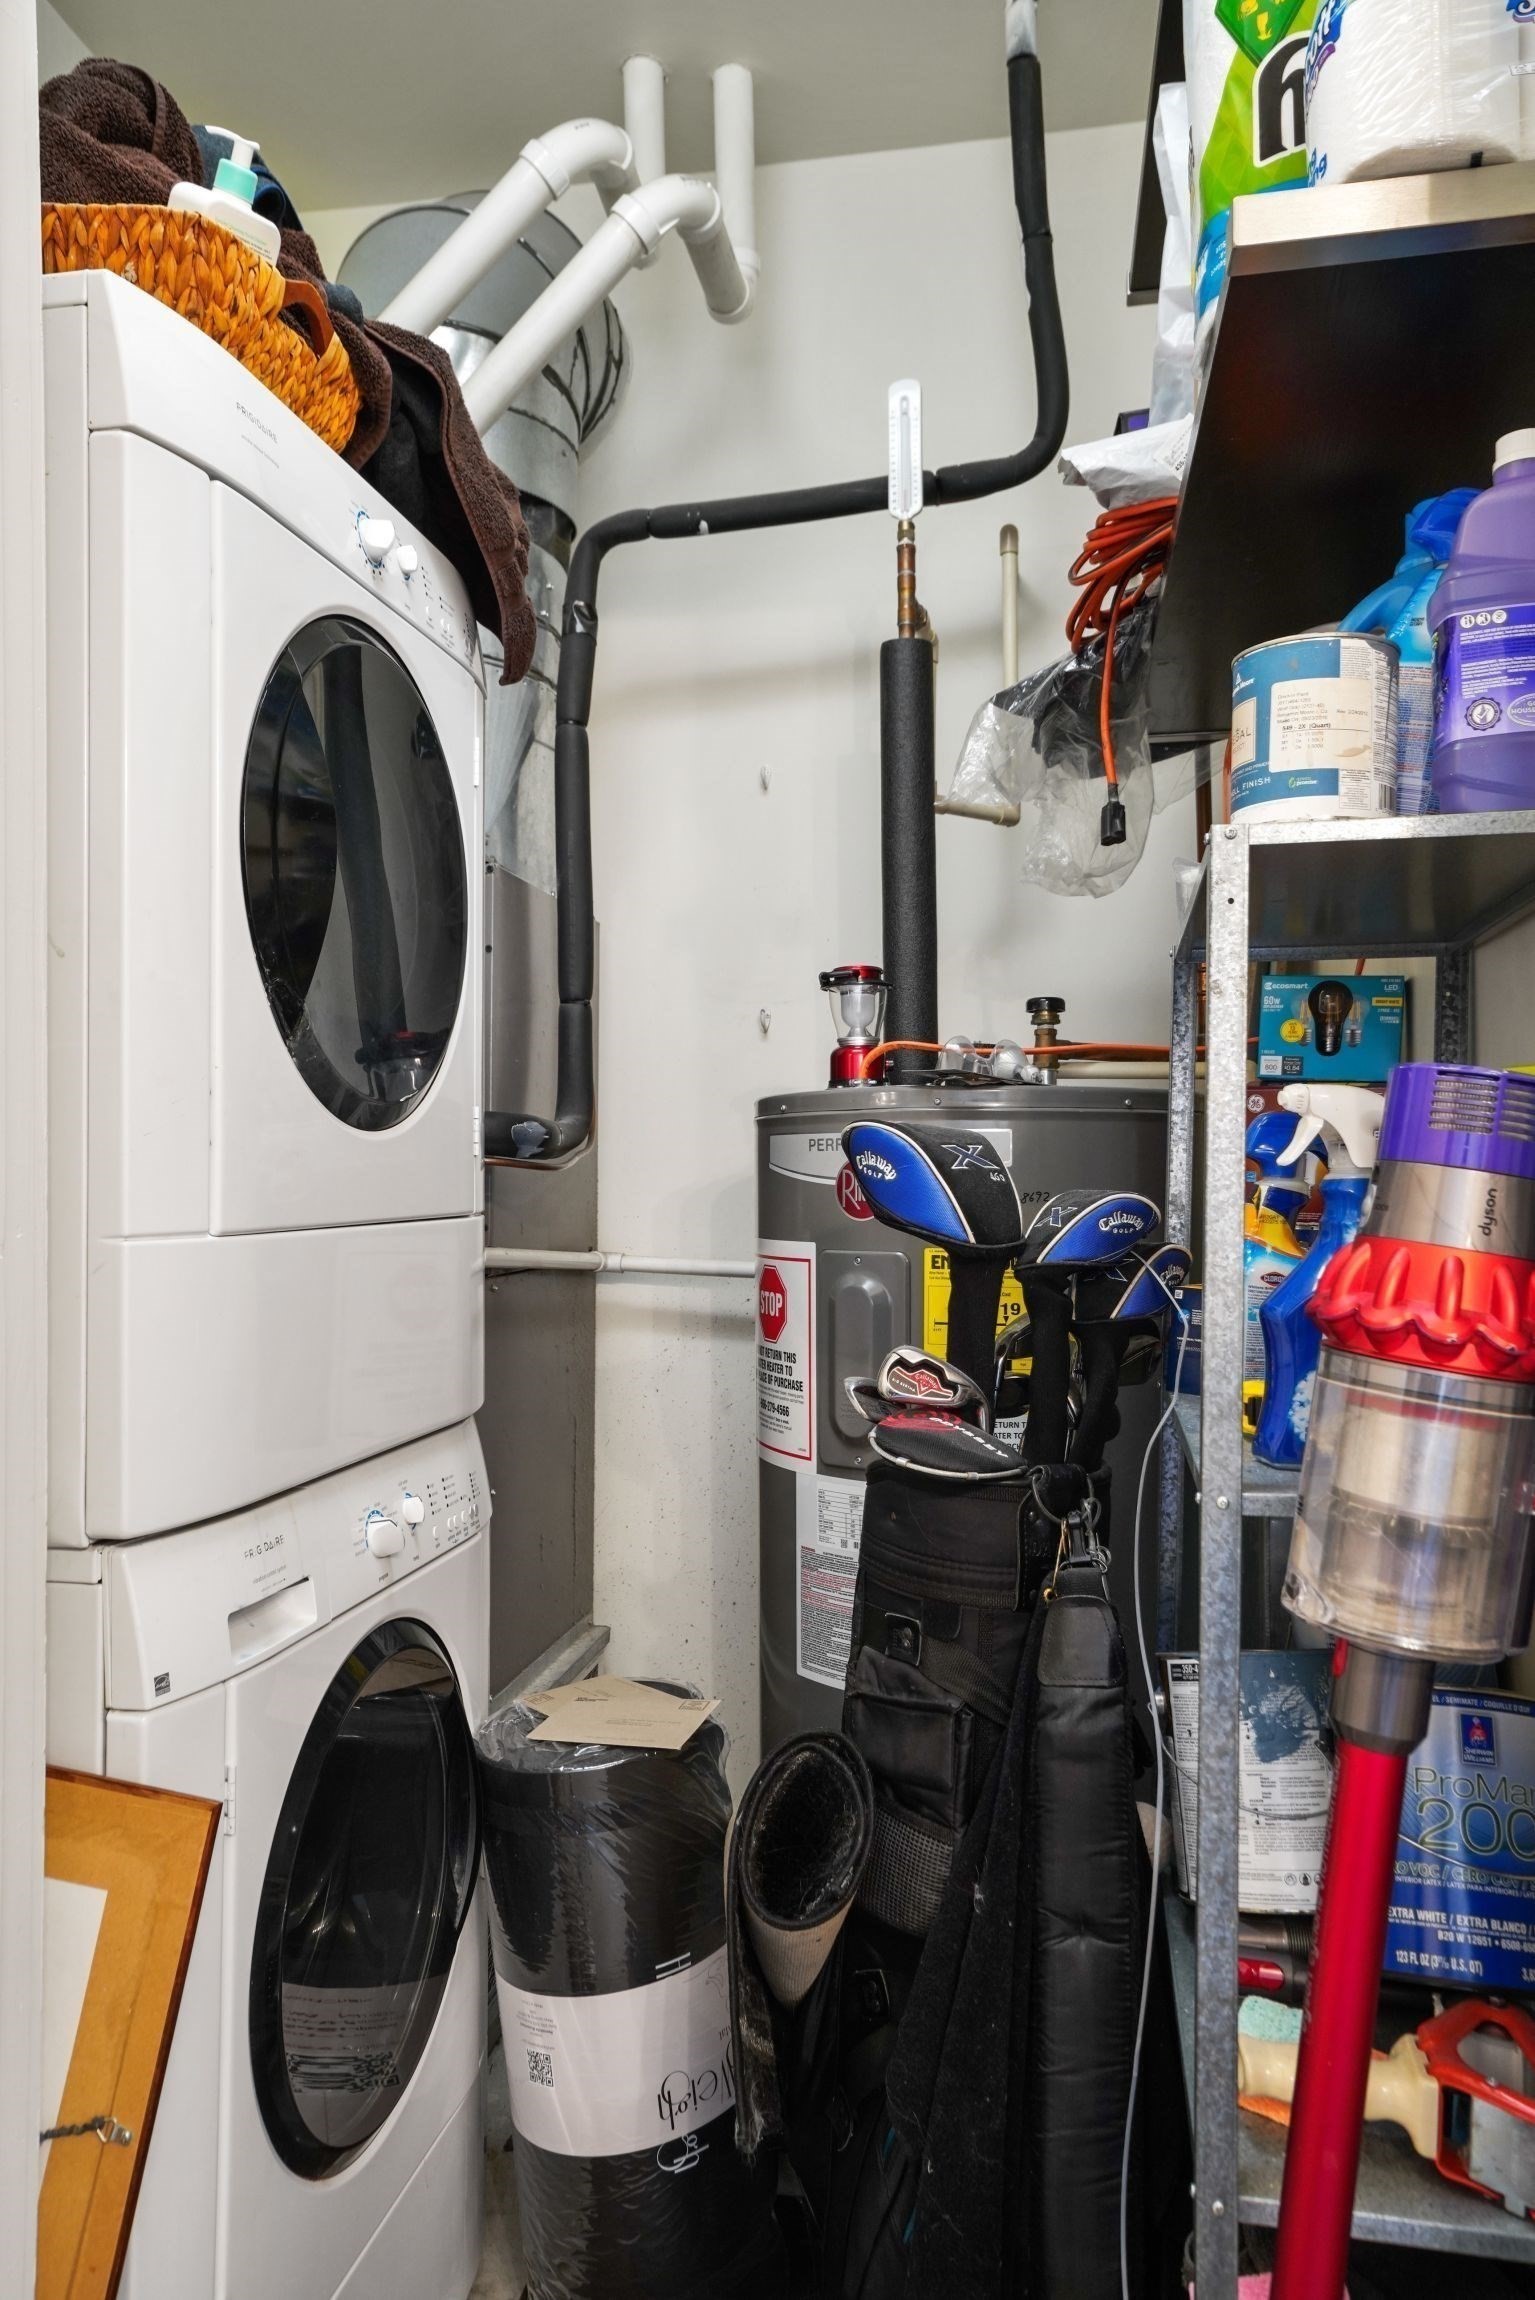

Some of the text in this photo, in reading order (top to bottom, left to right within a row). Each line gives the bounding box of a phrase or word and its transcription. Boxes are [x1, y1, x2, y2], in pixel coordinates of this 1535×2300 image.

[1242, 776, 1271, 790] FINISH
[1271, 982, 1309, 990] ecosmart
[856, 1150, 897, 1180] Callaway
[940, 1144, 1001, 1170] X
[863, 1167, 883, 1179] GOLF
[1478, 1188, 1497, 1236] dyson
[1098, 1211, 1144, 1231] Callaway
[760, 1290, 783, 1317] STOP
[765, 1347, 783, 1361] RETURN
[783, 1351, 797, 1364] THIS
[766, 1361, 784, 1375] HEATER
[785, 1365, 793, 1377] TO
[773, 1375, 804, 1392] PURCHASE
[993, 1421, 1020, 1429] ETURN
[1445, 1697, 1478, 1707] SEMIMATE
[1464, 1747, 1494, 1757] SHERWIN
[1464, 1754, 1494, 1764] WILLIAMS
[1423, 1879, 1442, 1888] LATEX
[1388, 1906, 1413, 1920] EXTRA
[1416, 1909, 1447, 1924] WHITE
[1456, 1914, 1488, 1929] EXTRA
[1490, 1919, 1526, 1935] BLANCO
[1395, 1950, 1409, 1965] 123
[1409, 1952, 1418, 1966] FL
[1420, 1954, 1430, 1968] OZ
[1451, 1957, 1468, 1972] U.S.
[1469, 1960, 1483, 1977] QT)
